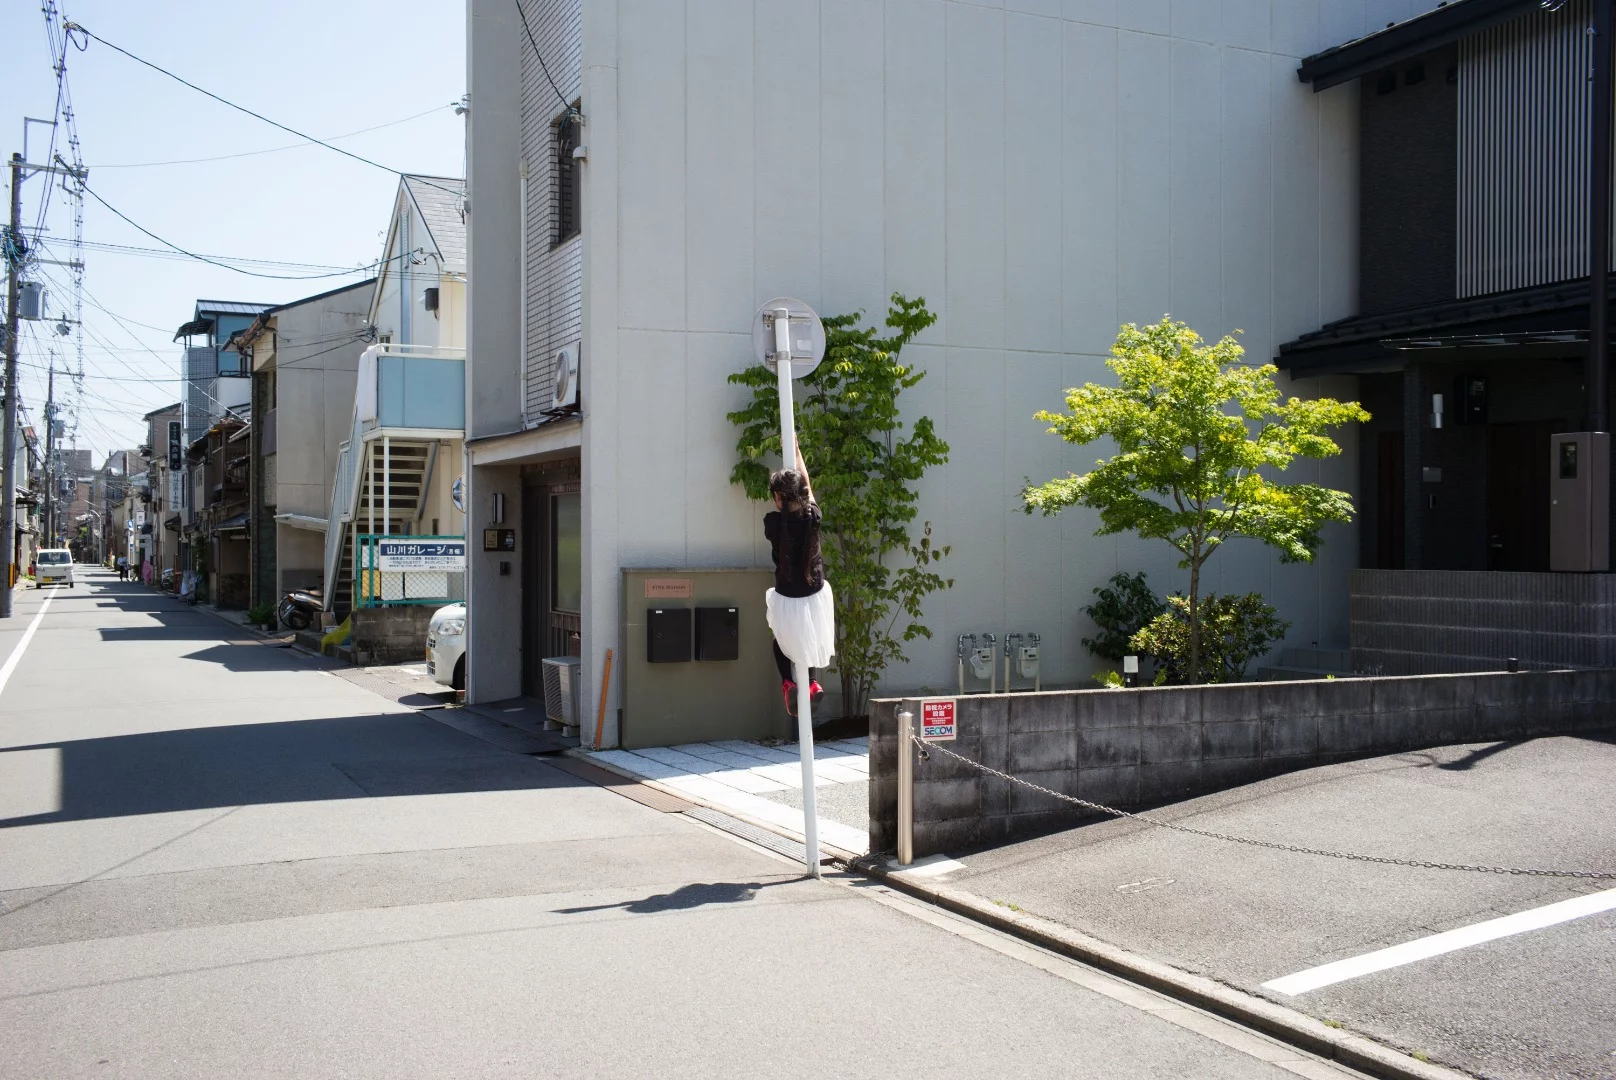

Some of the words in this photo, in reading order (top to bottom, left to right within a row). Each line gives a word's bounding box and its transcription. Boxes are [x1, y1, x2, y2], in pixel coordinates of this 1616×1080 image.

[387, 545, 446, 555] 山川ガレージ
[925, 726, 952, 736] SECOM
